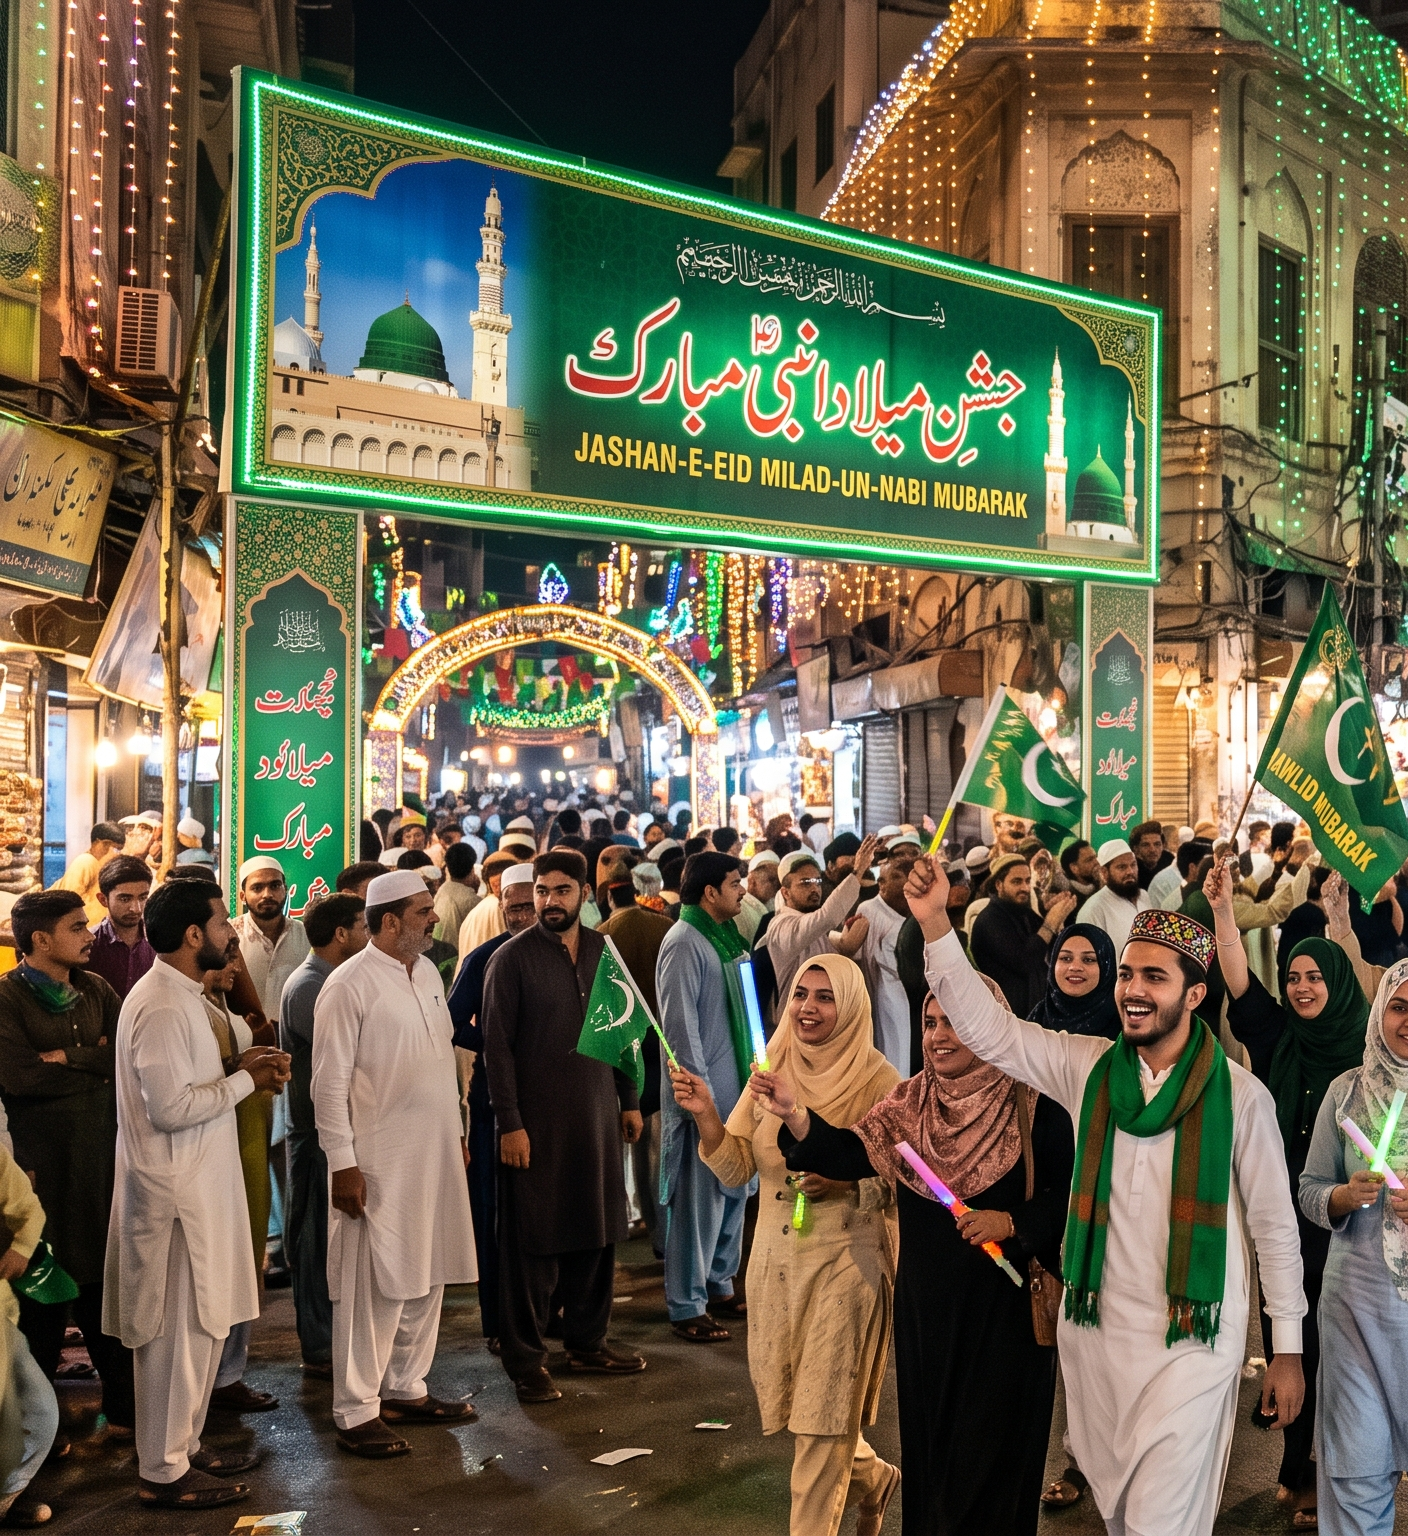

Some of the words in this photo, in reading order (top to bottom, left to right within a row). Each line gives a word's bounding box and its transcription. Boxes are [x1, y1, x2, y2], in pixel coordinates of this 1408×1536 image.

[574, 431, 753, 484] JASHAN-E-EID
[760, 457, 927, 506] MILAD-UN-NABI
[932, 480, 1028, 519] MUBARAK
[1311, 791, 1378, 874] MUBARAK
